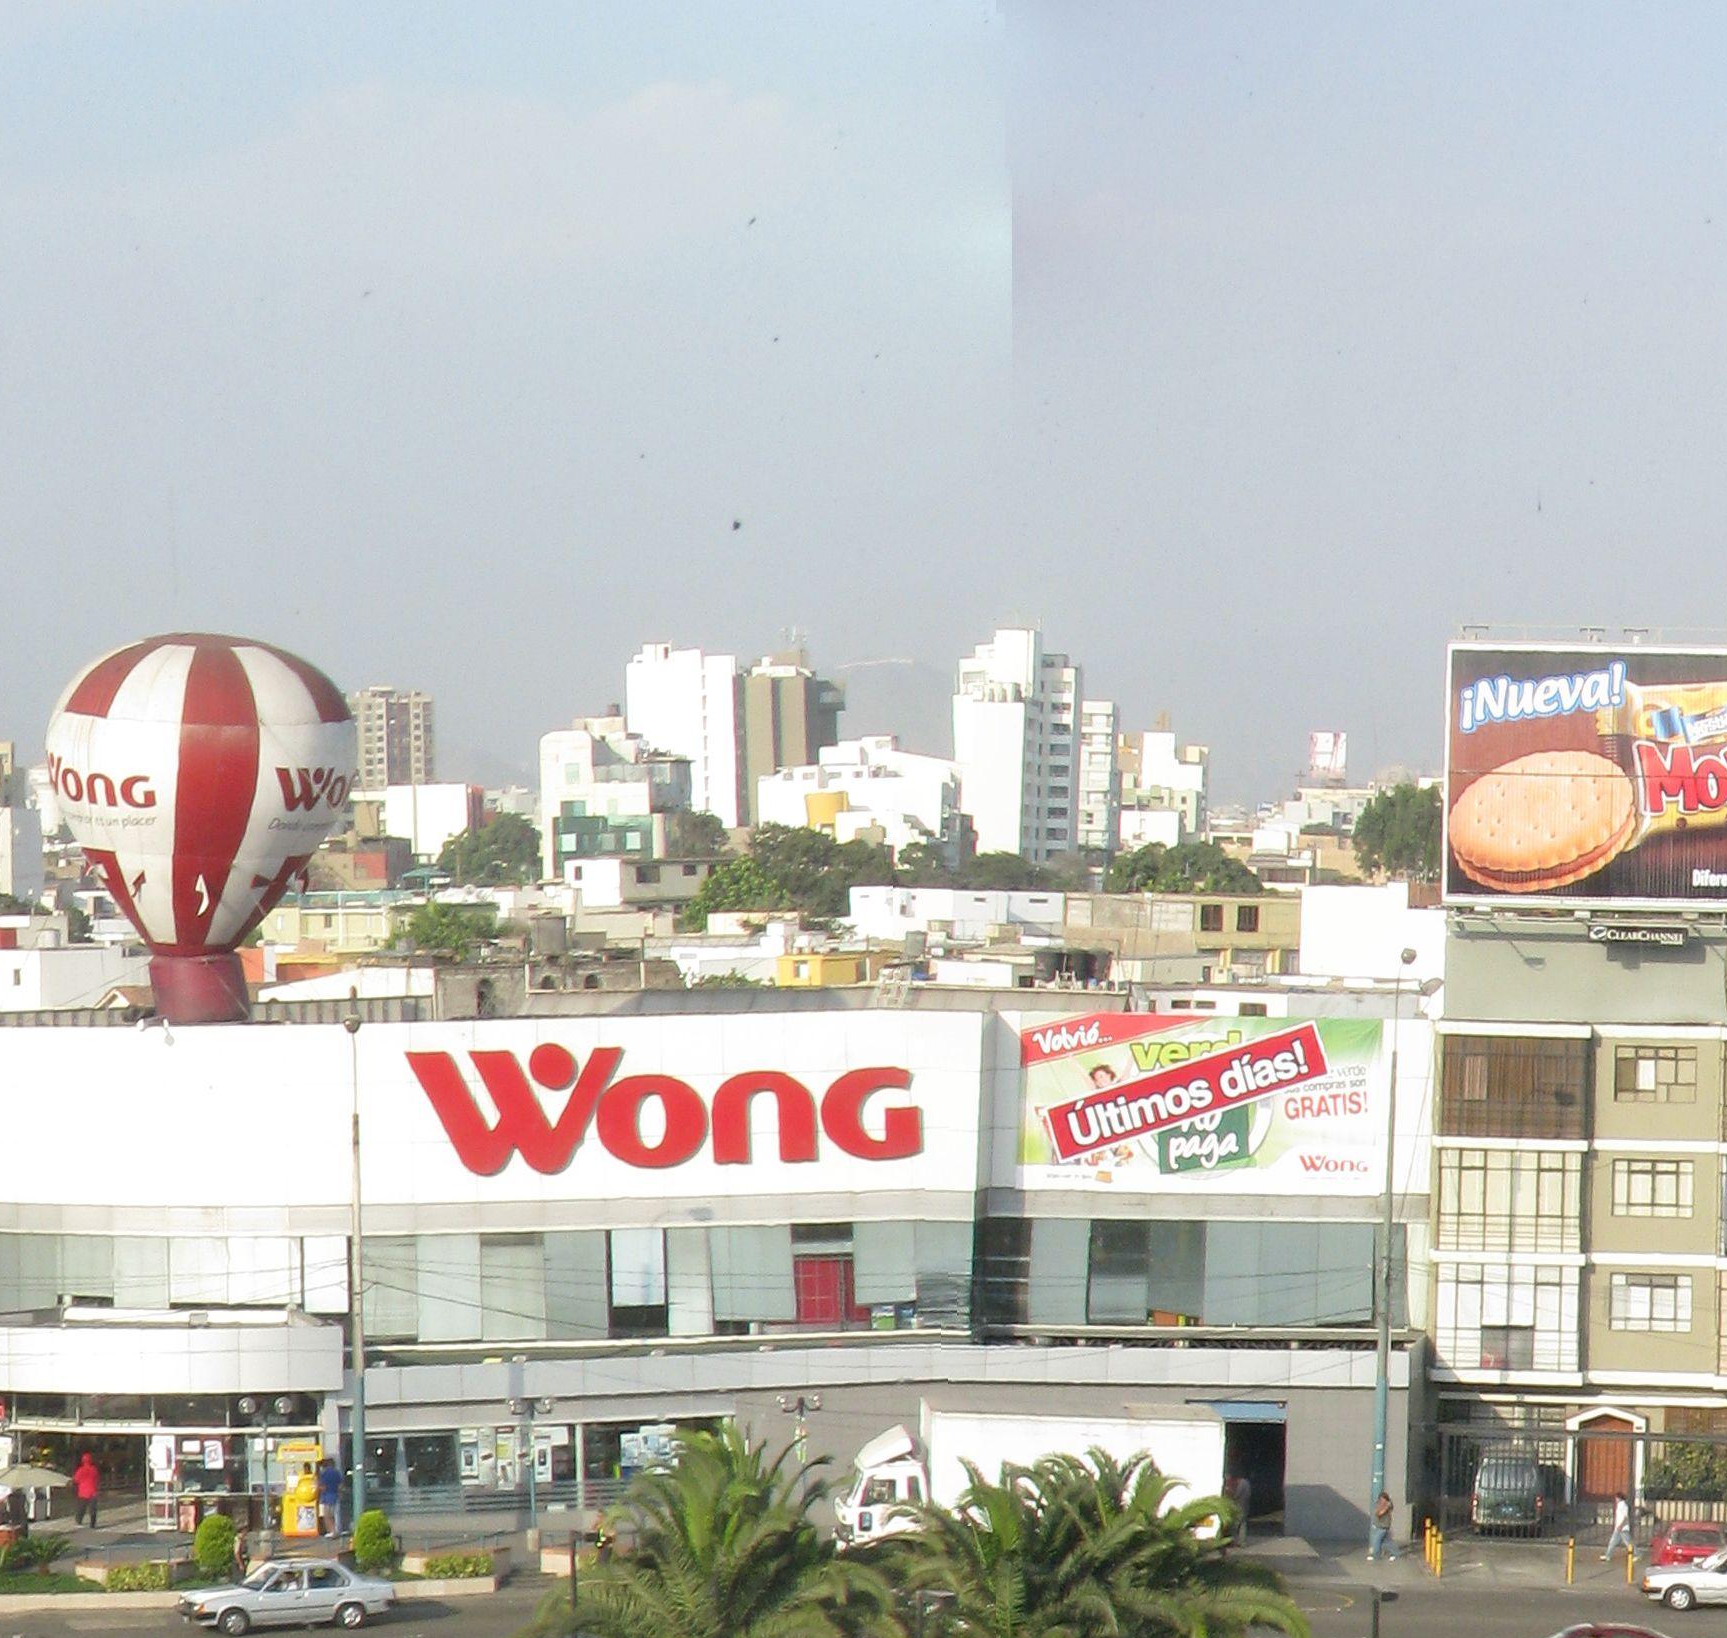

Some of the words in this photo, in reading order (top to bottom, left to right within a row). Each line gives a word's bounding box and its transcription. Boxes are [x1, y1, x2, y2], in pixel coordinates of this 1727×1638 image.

[1460, 662, 1626, 733] ¡Nueva!
[1067, 1076, 1214, 1147] Últimos
[1218, 1038, 1310, 1096] días!
[1303, 1079, 1347, 1092] compras
[1349, 1078, 1366, 1088] son
[1284, 1091, 1368, 1120] GRATIS!
[1168, 1132, 1240, 1171] paga
